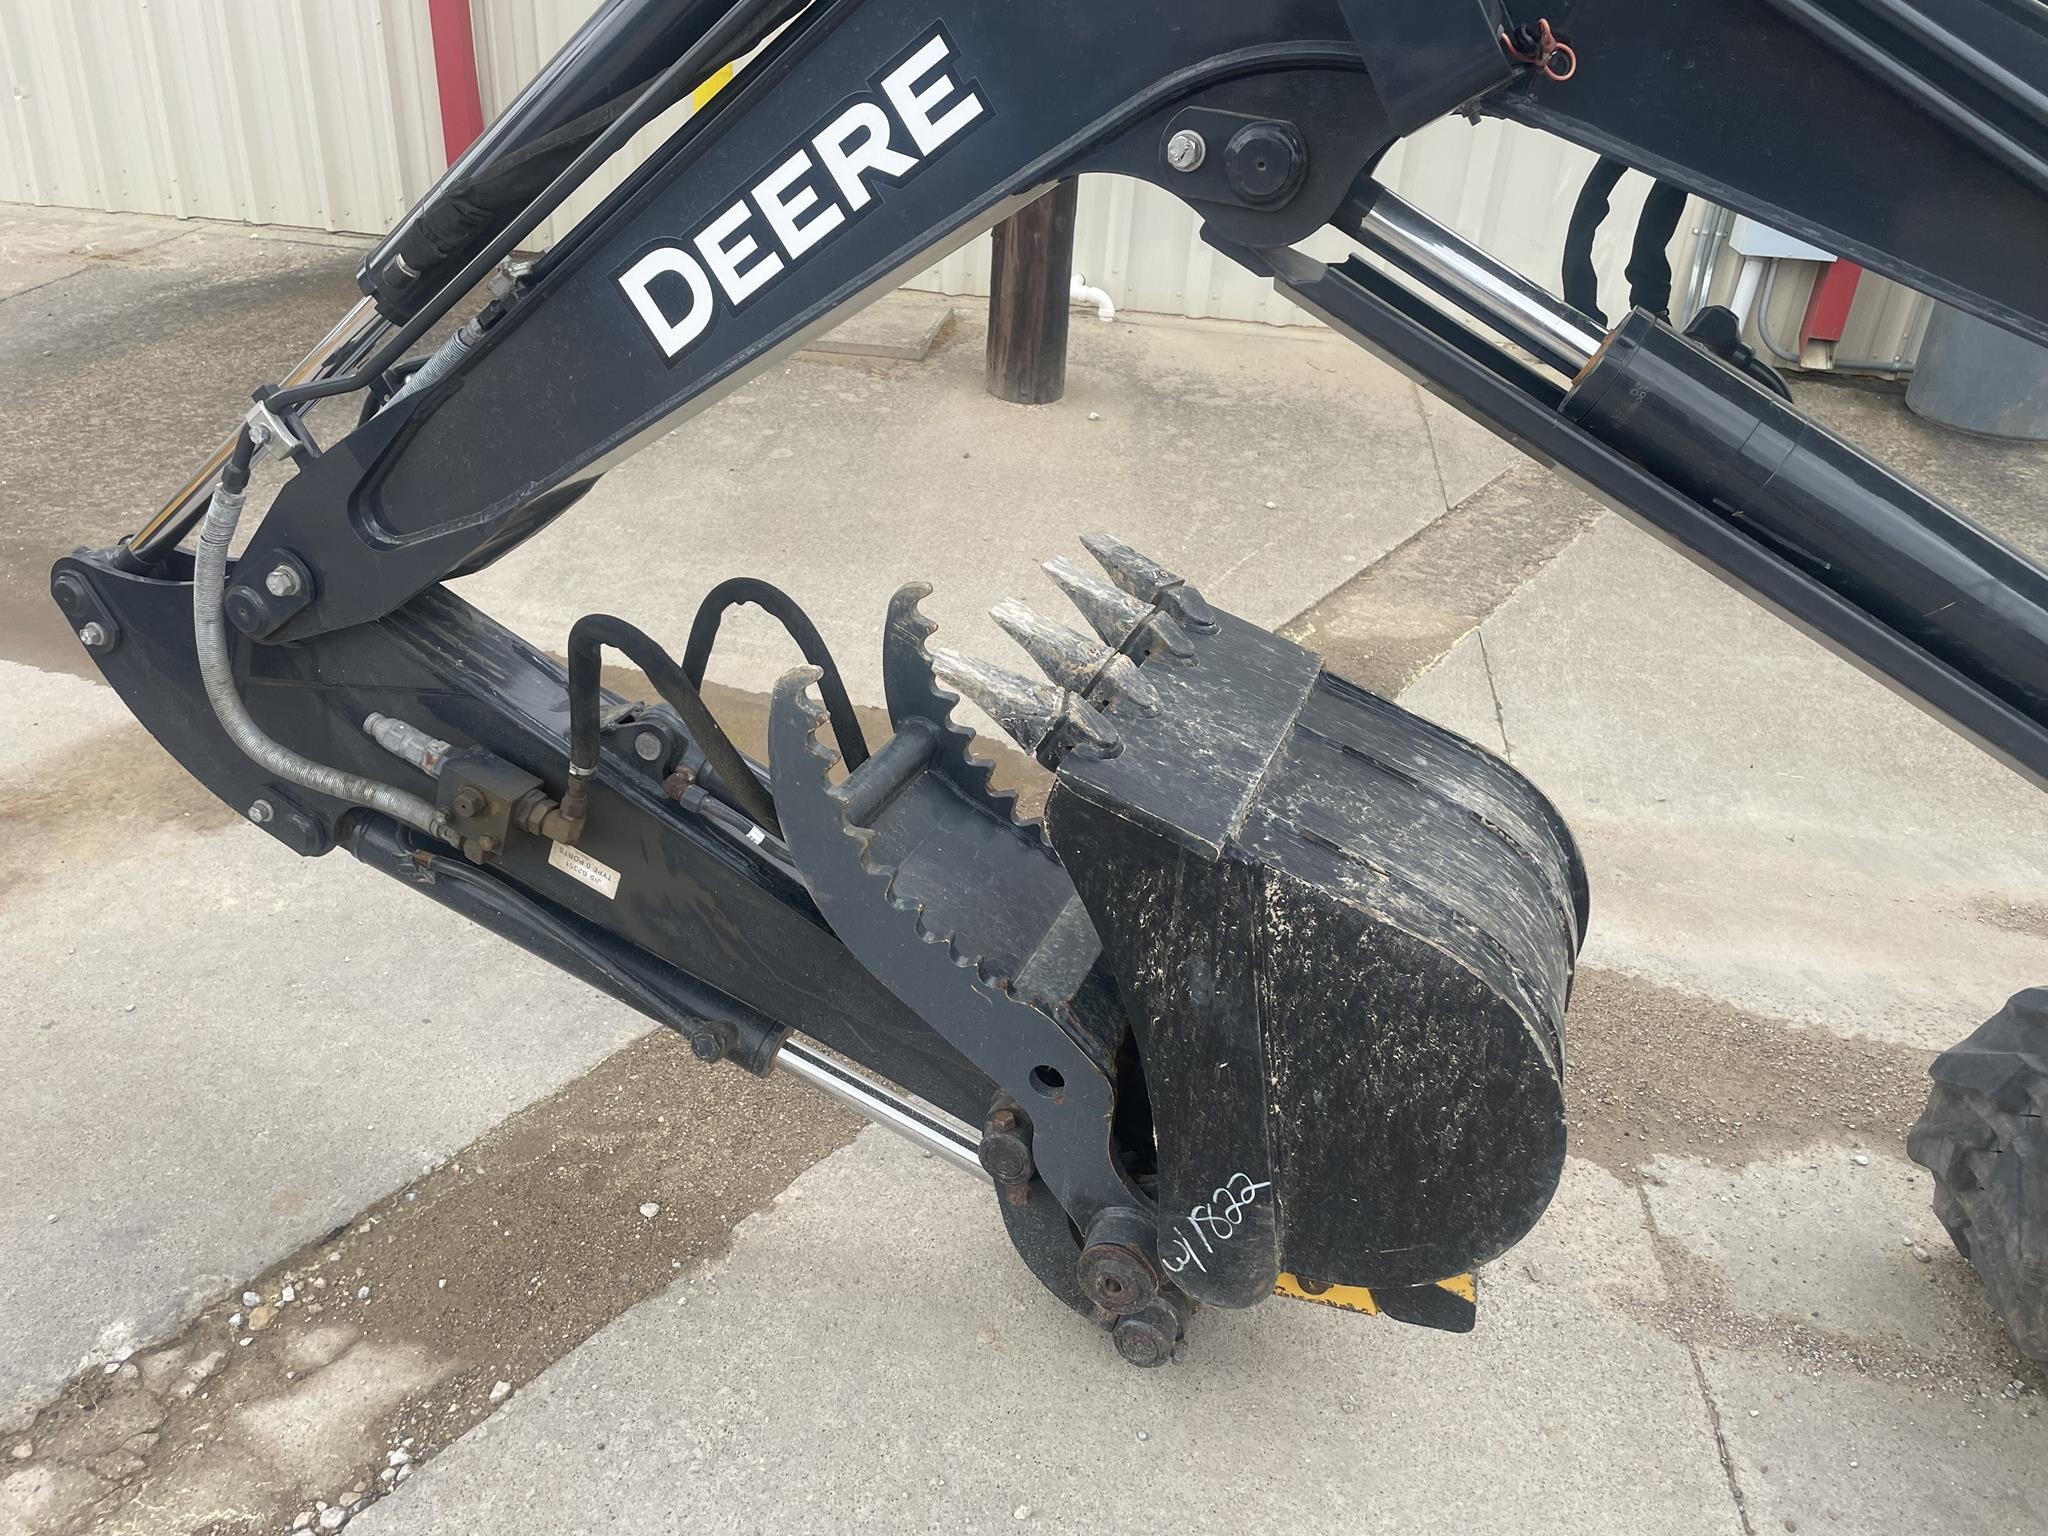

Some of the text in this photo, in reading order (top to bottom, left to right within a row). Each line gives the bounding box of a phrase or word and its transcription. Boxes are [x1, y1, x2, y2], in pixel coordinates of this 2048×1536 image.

[618, 35, 984, 358] DEERE
[559, 847, 585, 866] PORTS
[593, 866, 612, 881] TYPE
